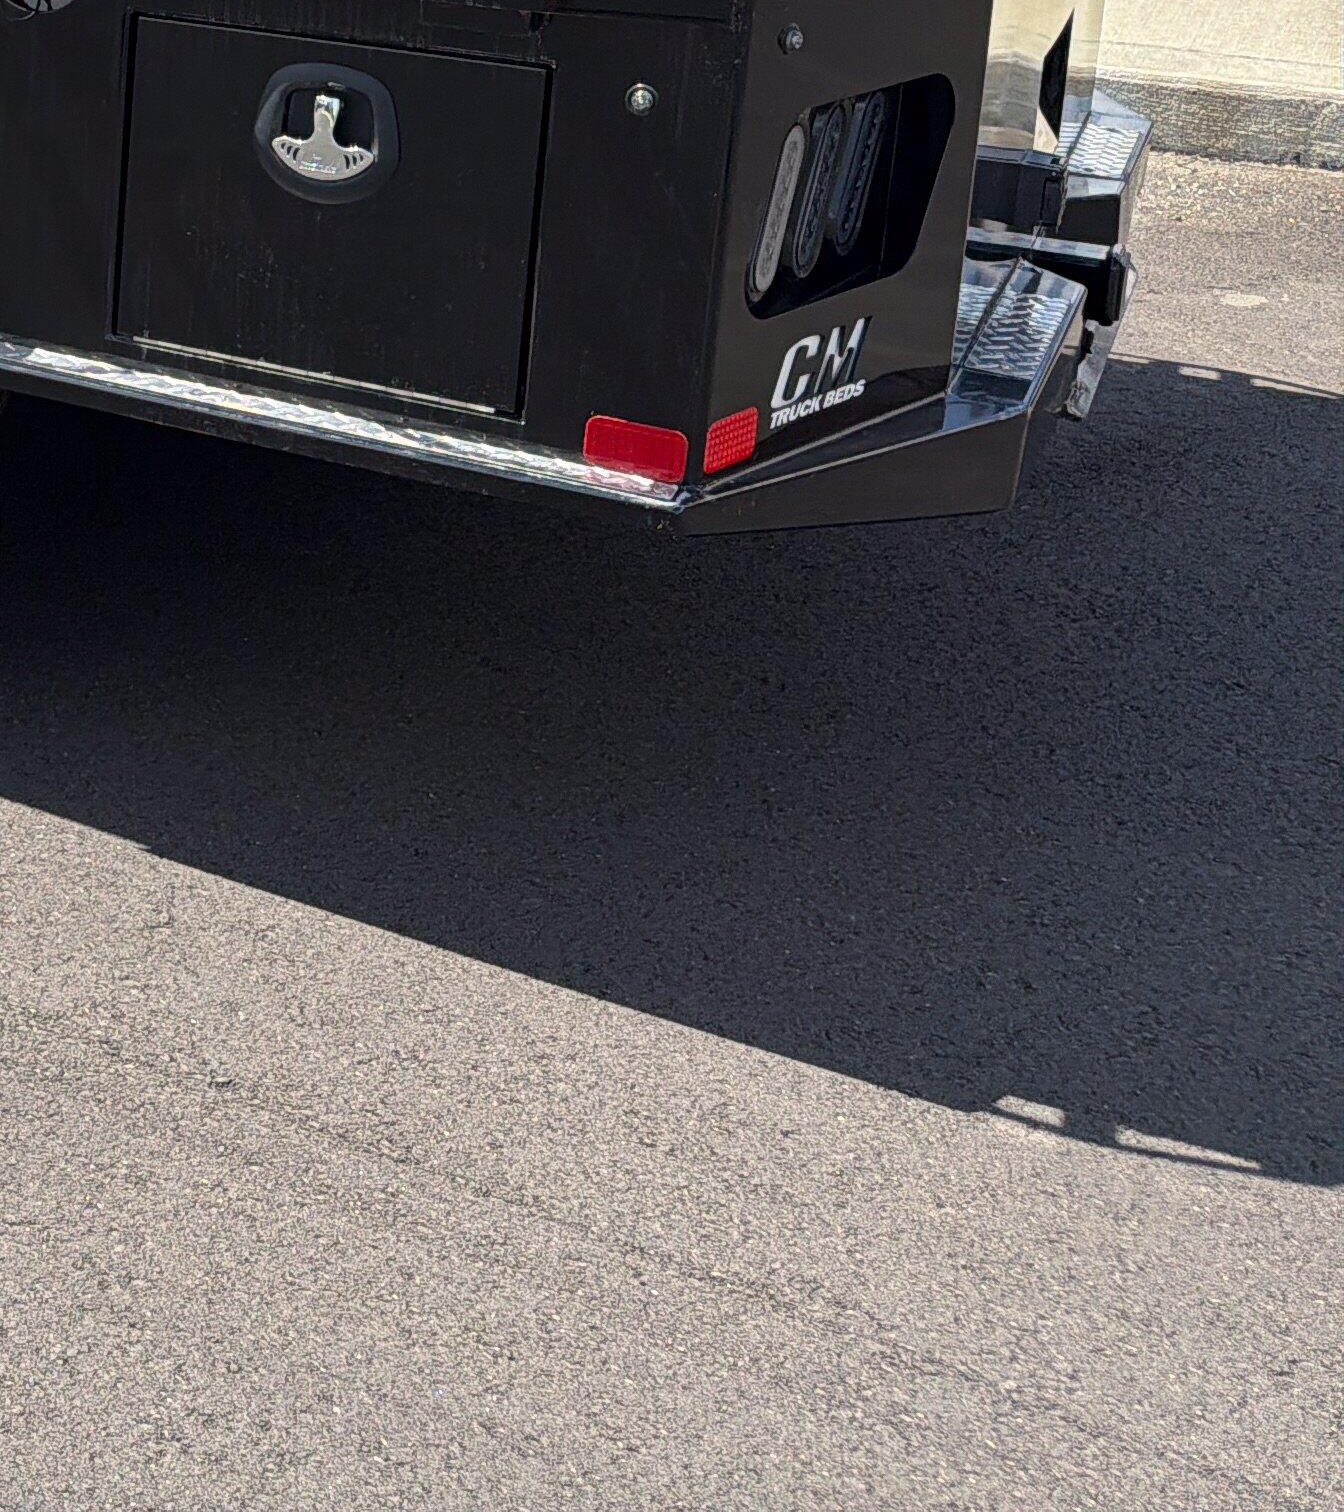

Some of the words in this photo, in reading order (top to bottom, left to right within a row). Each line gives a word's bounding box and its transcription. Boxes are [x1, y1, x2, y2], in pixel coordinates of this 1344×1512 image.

[770, 317, 867, 408] CM
[770, 394, 821, 429] TRUCK
[823, 379, 866, 409] BEDS
